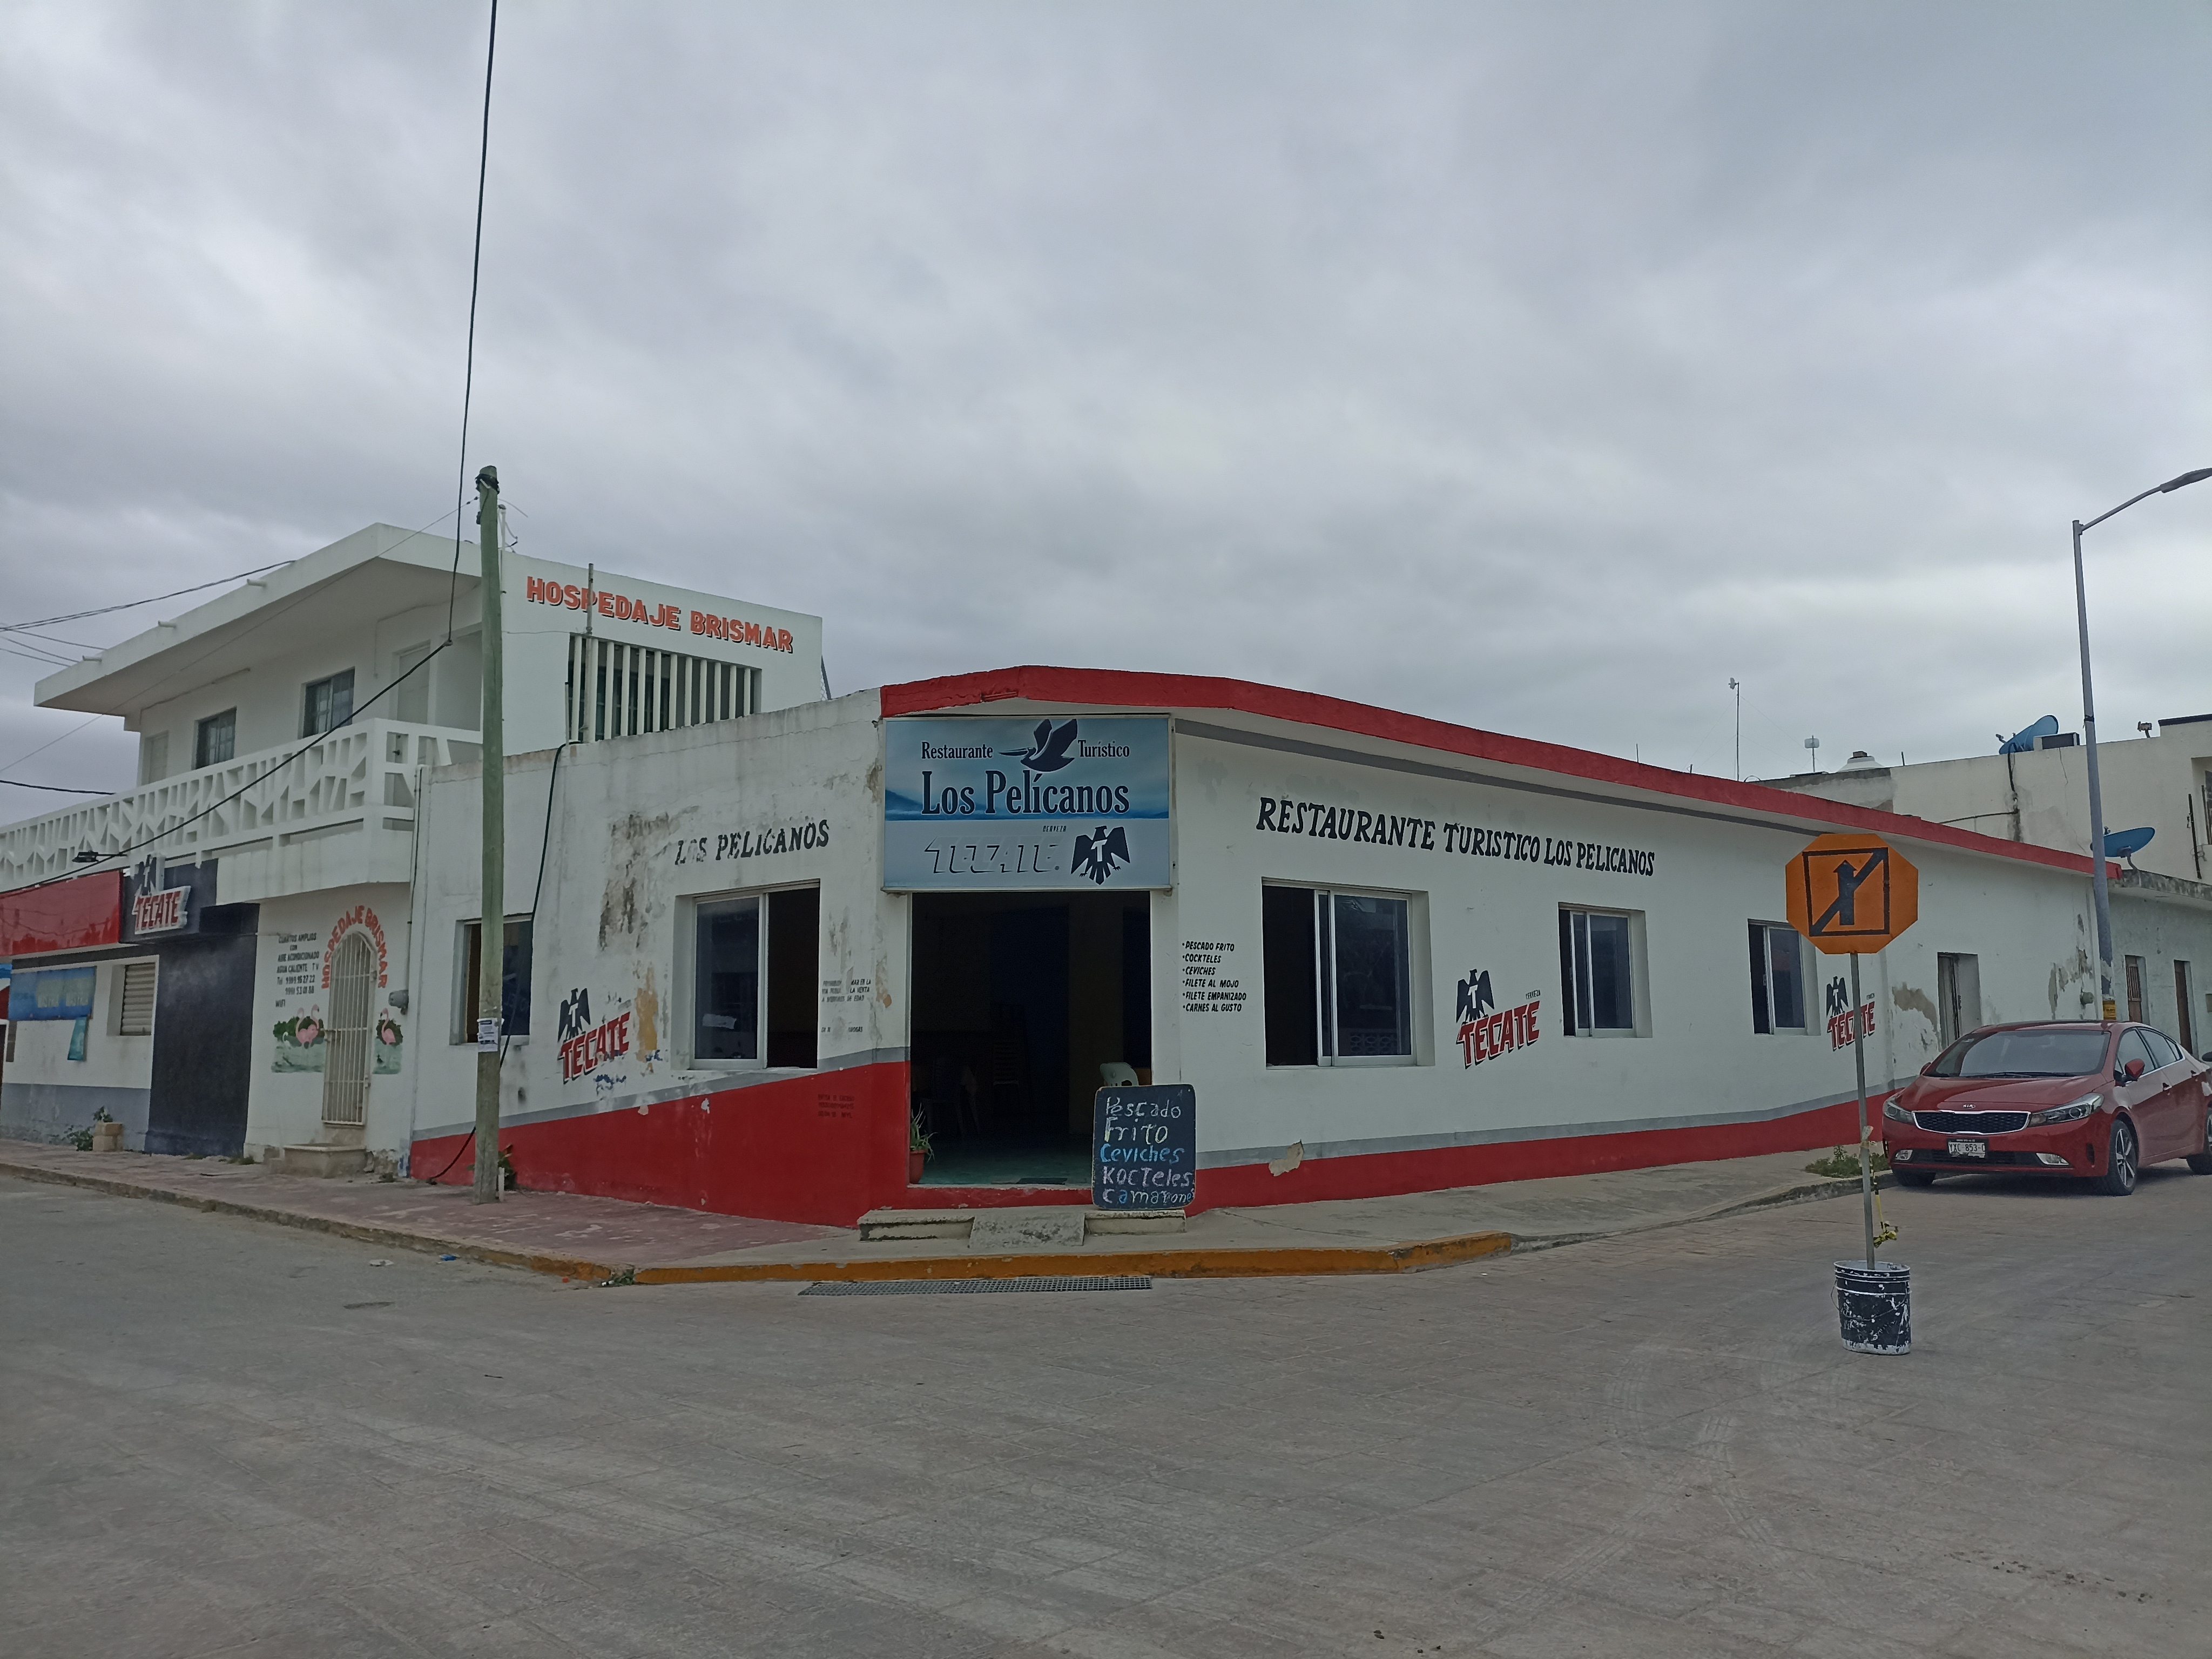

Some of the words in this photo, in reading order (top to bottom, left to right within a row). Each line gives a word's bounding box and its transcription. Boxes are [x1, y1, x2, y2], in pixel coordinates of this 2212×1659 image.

[526, 576, 681, 631] HOSPEDAJE
[690, 610, 793, 654] BRISMAR
[921, 741, 994, 759] Restaurante
[1078, 739, 1130, 758] Turístico
[921, 771, 975, 815] Los
[985, 769, 1130, 814] Pelícanos
[715, 819, 830, 861] PELICANOS
[1256, 797, 1436, 851] RESTAURANTE
[1443, 822, 1541, 864] TURISTICO
[1544, 838, 1573, 866] LOS
[1576, 841, 1655, 877] PELICANOS
[924, 836, 1067, 874] TECATE
[134, 891, 182, 930] TECATE
[321, 905, 365, 989] HOSPEDAJE
[1185, 941, 1214, 950] PESCADO
[1215, 942, 1235, 952] FRITO
[1185, 953, 1222, 963] COCKTELES
[1185, 966, 1216, 975] CEVICHES
[1185, 979, 1206, 988] FILETE
[1208, 979, 1216, 988] AL
[1219, 980, 1239, 988] MOJO
[1185, 991, 1205, 1000] FILETE
[1207, 992, 1247, 1001] EMPANIZADO
[1185, 1003, 1210, 1012] CARNES
[1211, 1003, 1218, 1012] AL
[1220, 1003, 1242, 1012] GUSTO
[1455, 1000, 1541, 1070] TECATE
[1826, 1001, 1876, 1053] TECTE
[557, 1011, 631, 1085] TECATE
[1106, 1096, 1182, 1119] Pescado
[1104, 1116, 1168, 1144] Frito
[1100, 1143, 1185, 1164] Ceviches
